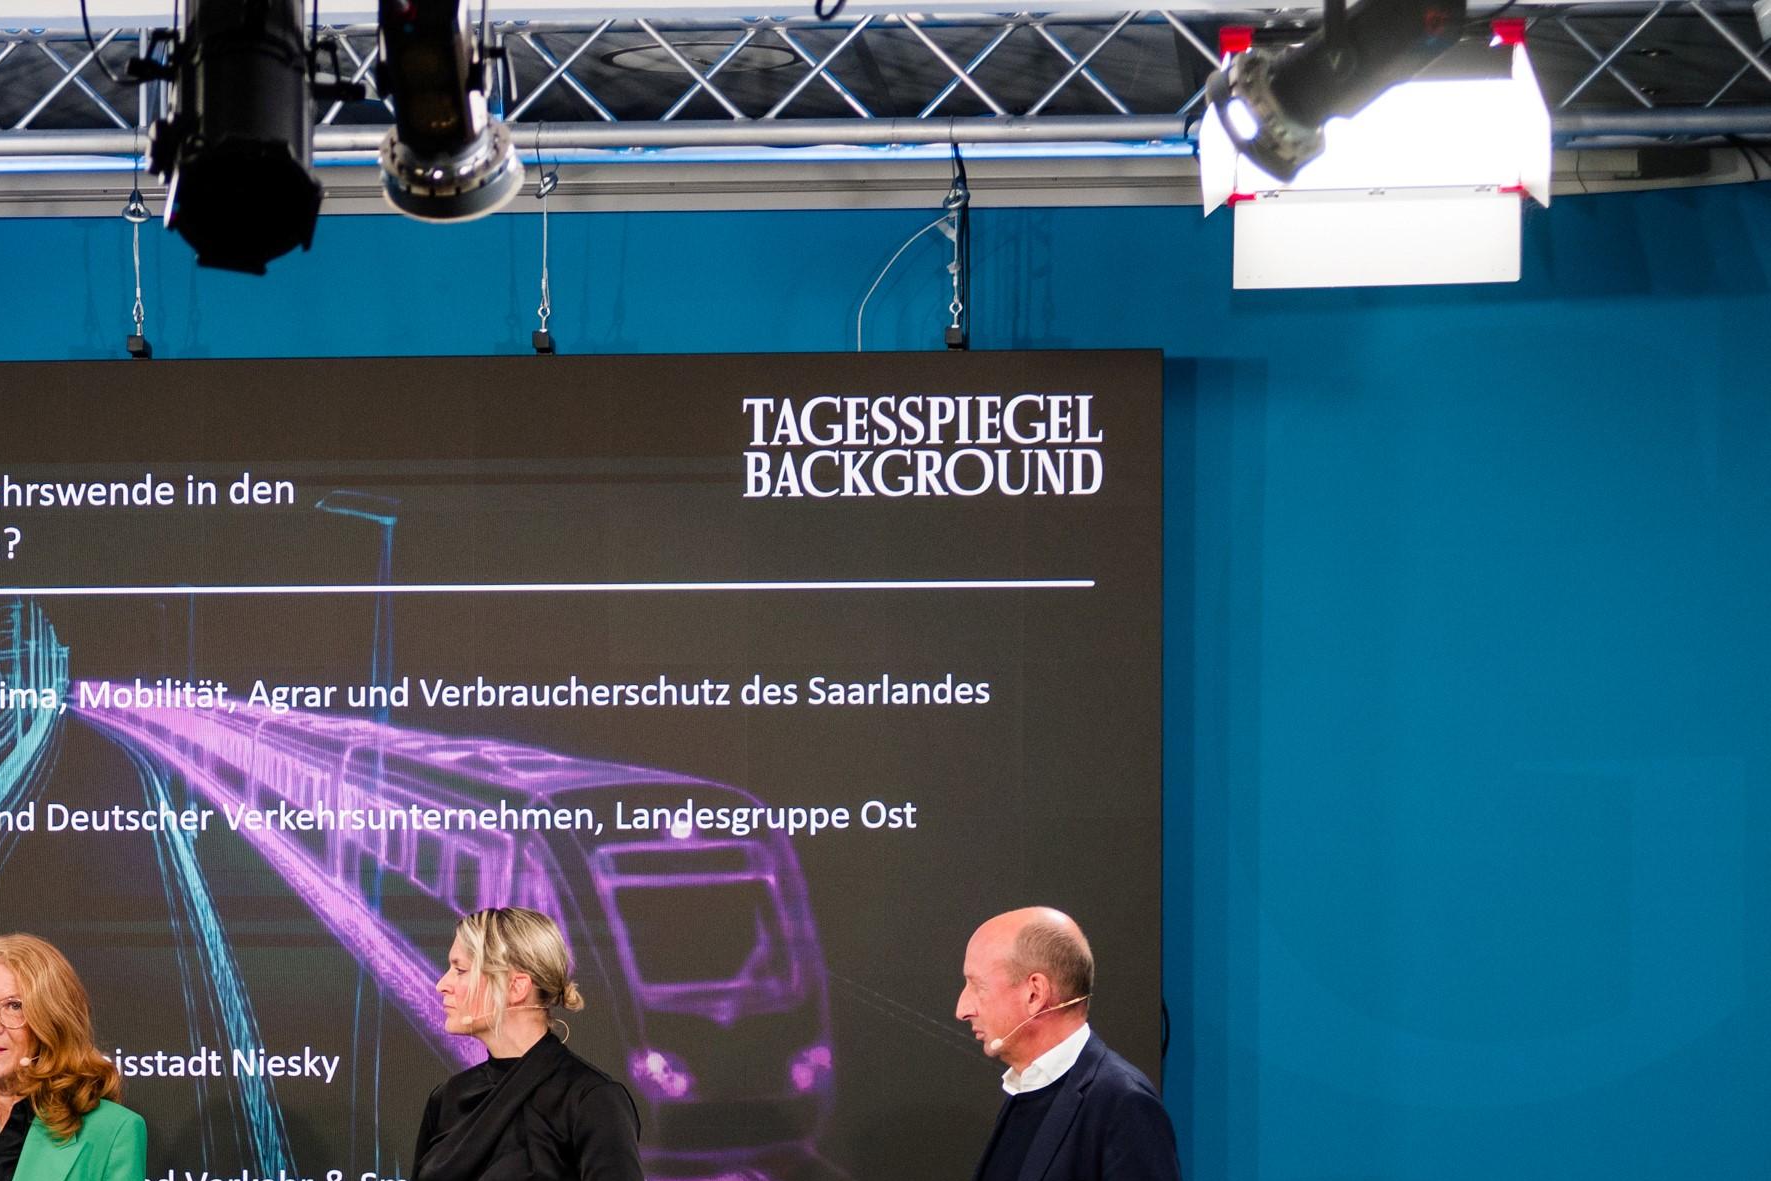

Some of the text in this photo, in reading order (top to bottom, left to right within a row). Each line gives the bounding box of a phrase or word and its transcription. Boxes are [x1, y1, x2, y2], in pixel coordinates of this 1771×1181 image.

[743, 395, 1103, 445] TAGESSPIEGEL
[187, 474, 217, 505] in
[229, 472, 294, 505] den
[743, 449, 1103, 498] BACKGROUND
[80, 679, 236, 714] Mobilität,
[247, 678, 337, 714] Agrar
[348, 677, 409, 707] und
[419, 676, 731, 707] Verbraucherschutz
[741, 675, 798, 705] des
[808, 674, 990, 705] Saarlandes
[46, 801, 214, 832] Deutscher
[224, 800, 603, 838] Verkehrsunternehmen,
[616, 799, 850, 838] Landesgruppe
[861, 800, 917, 829] Ost
[102, 1046, 222, 1077] isstadt
[233, 1047, 340, 1084] Niesky
